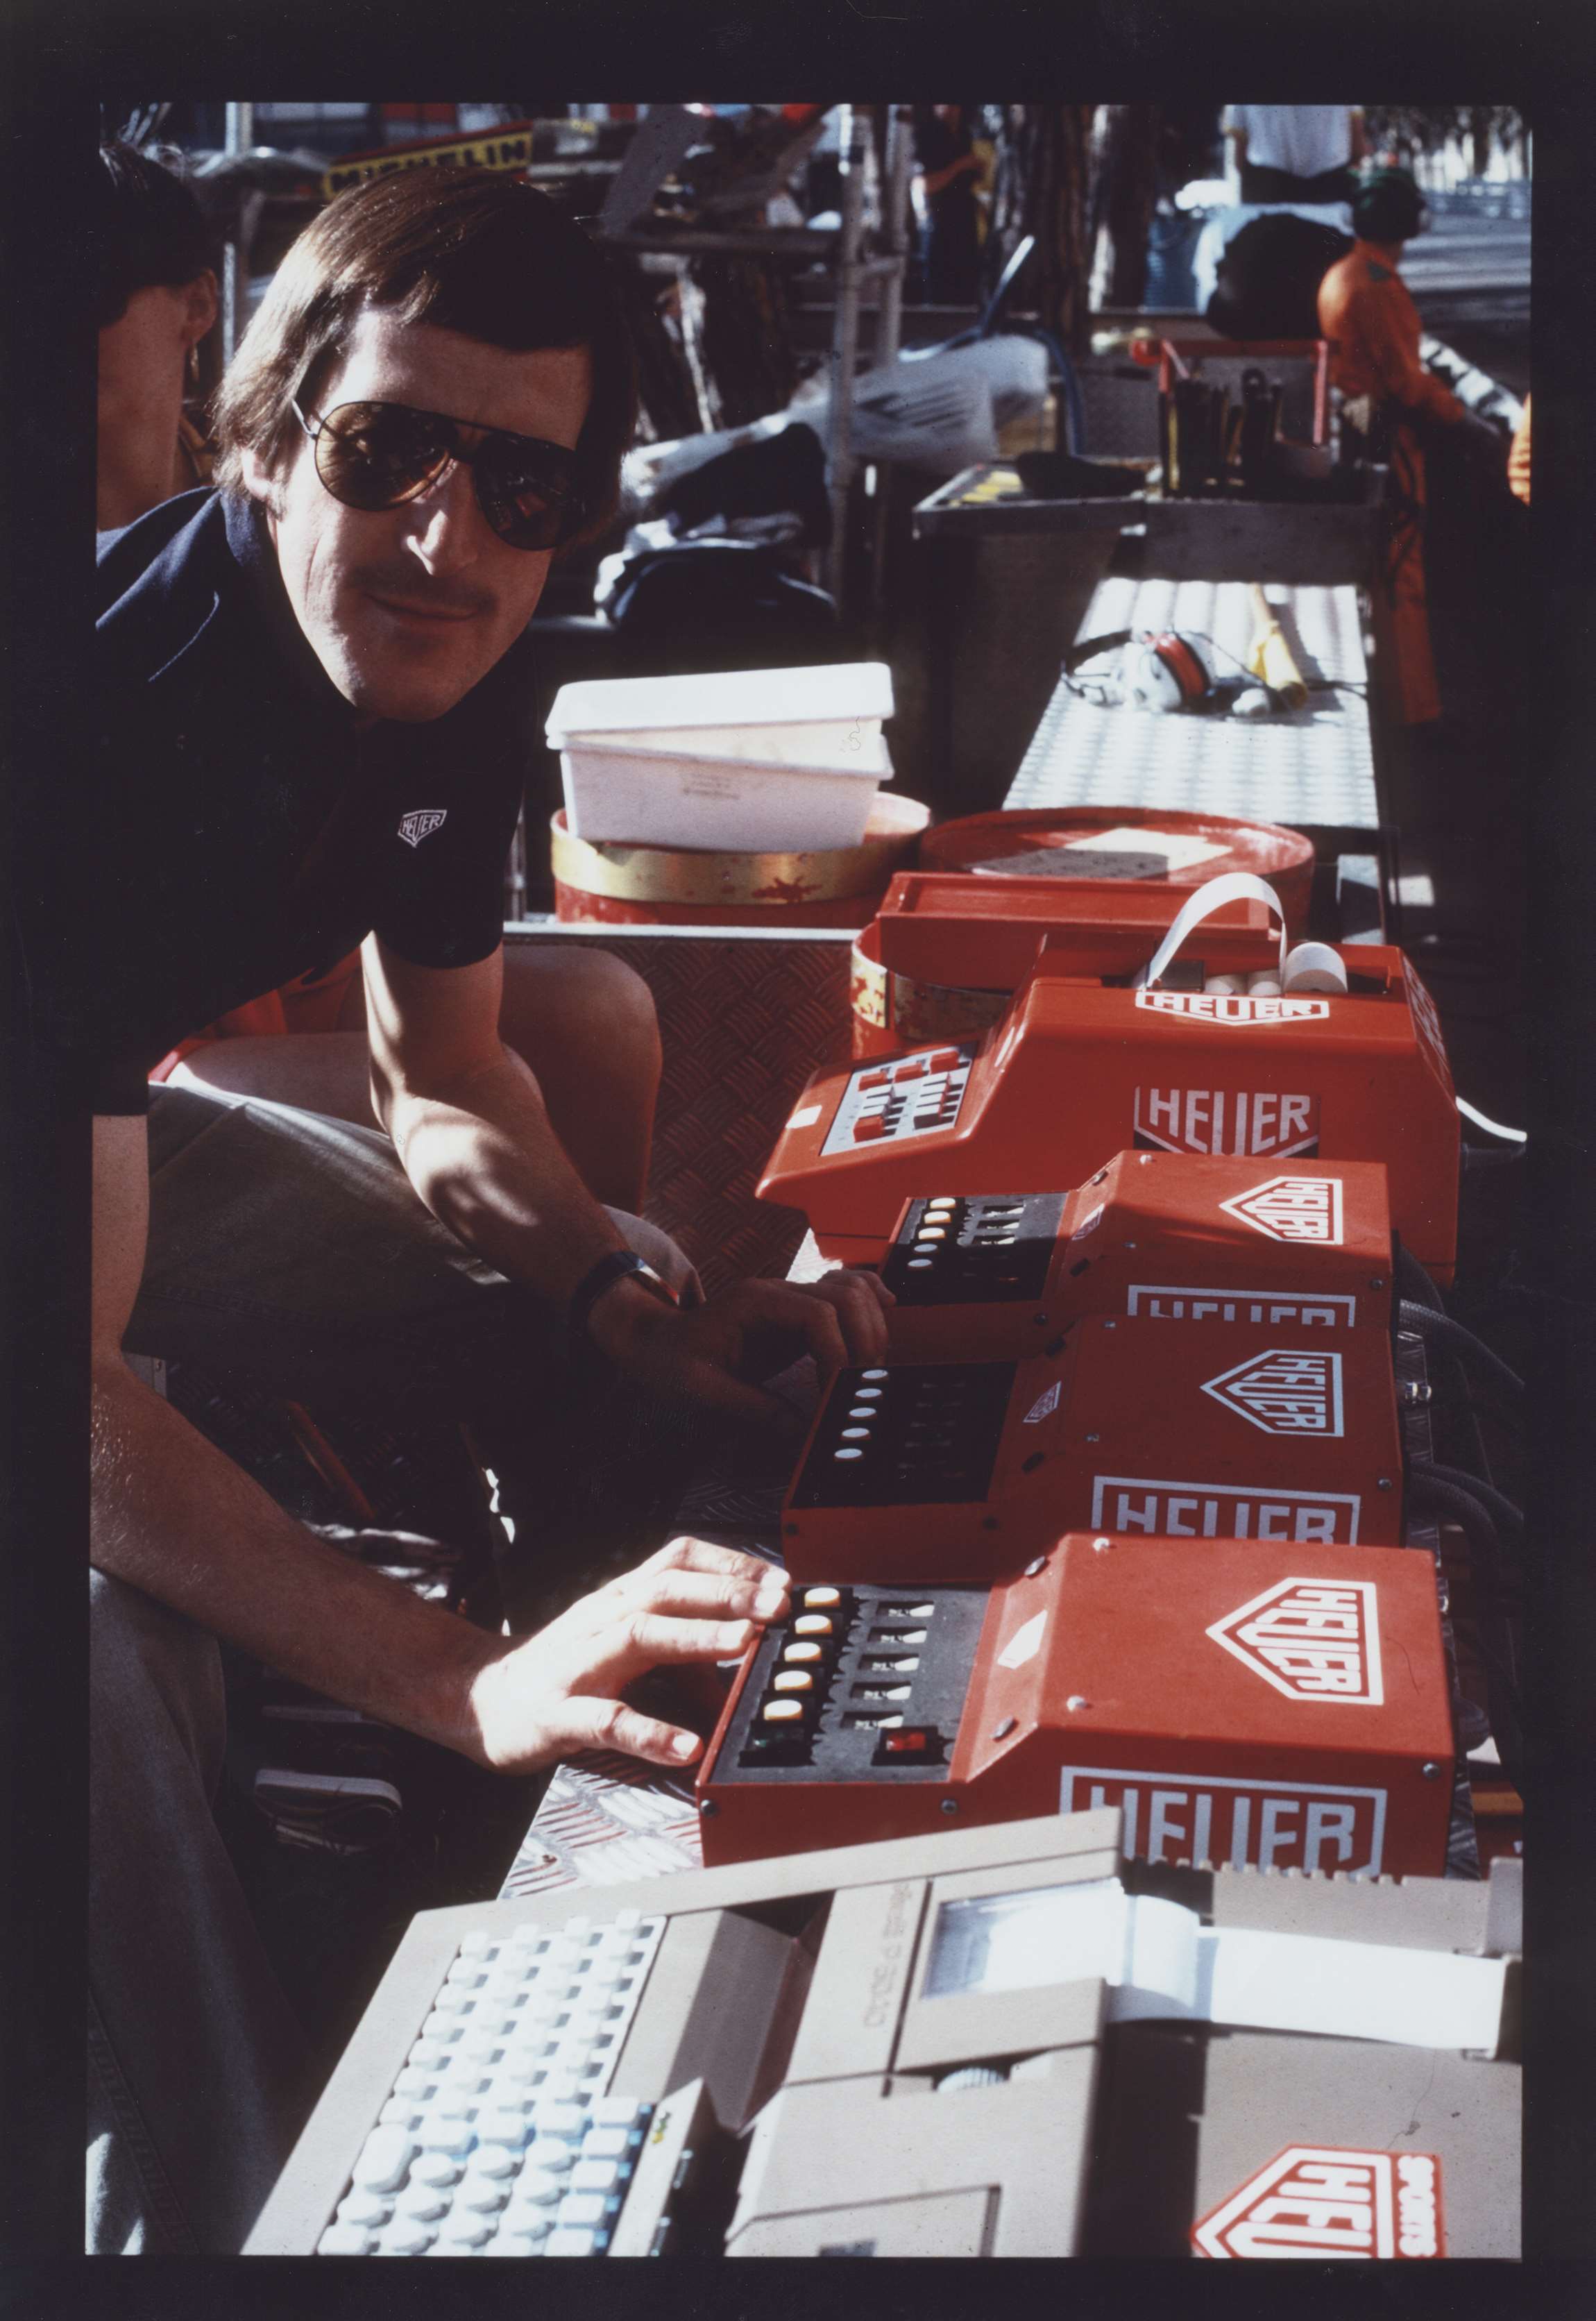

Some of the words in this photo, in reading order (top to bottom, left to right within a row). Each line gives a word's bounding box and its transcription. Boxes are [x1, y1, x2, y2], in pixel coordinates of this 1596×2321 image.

[402, 814, 441, 842] HEUER
[1153, 995, 1313, 1020] HEUER
[1149, 1088, 1311, 1156] HEUER
[1241, 1183, 1328, 1239] HEUER
[1225, 1358, 1326, 1428] HEUER
[1237, 1589, 1361, 1693] HEUER
